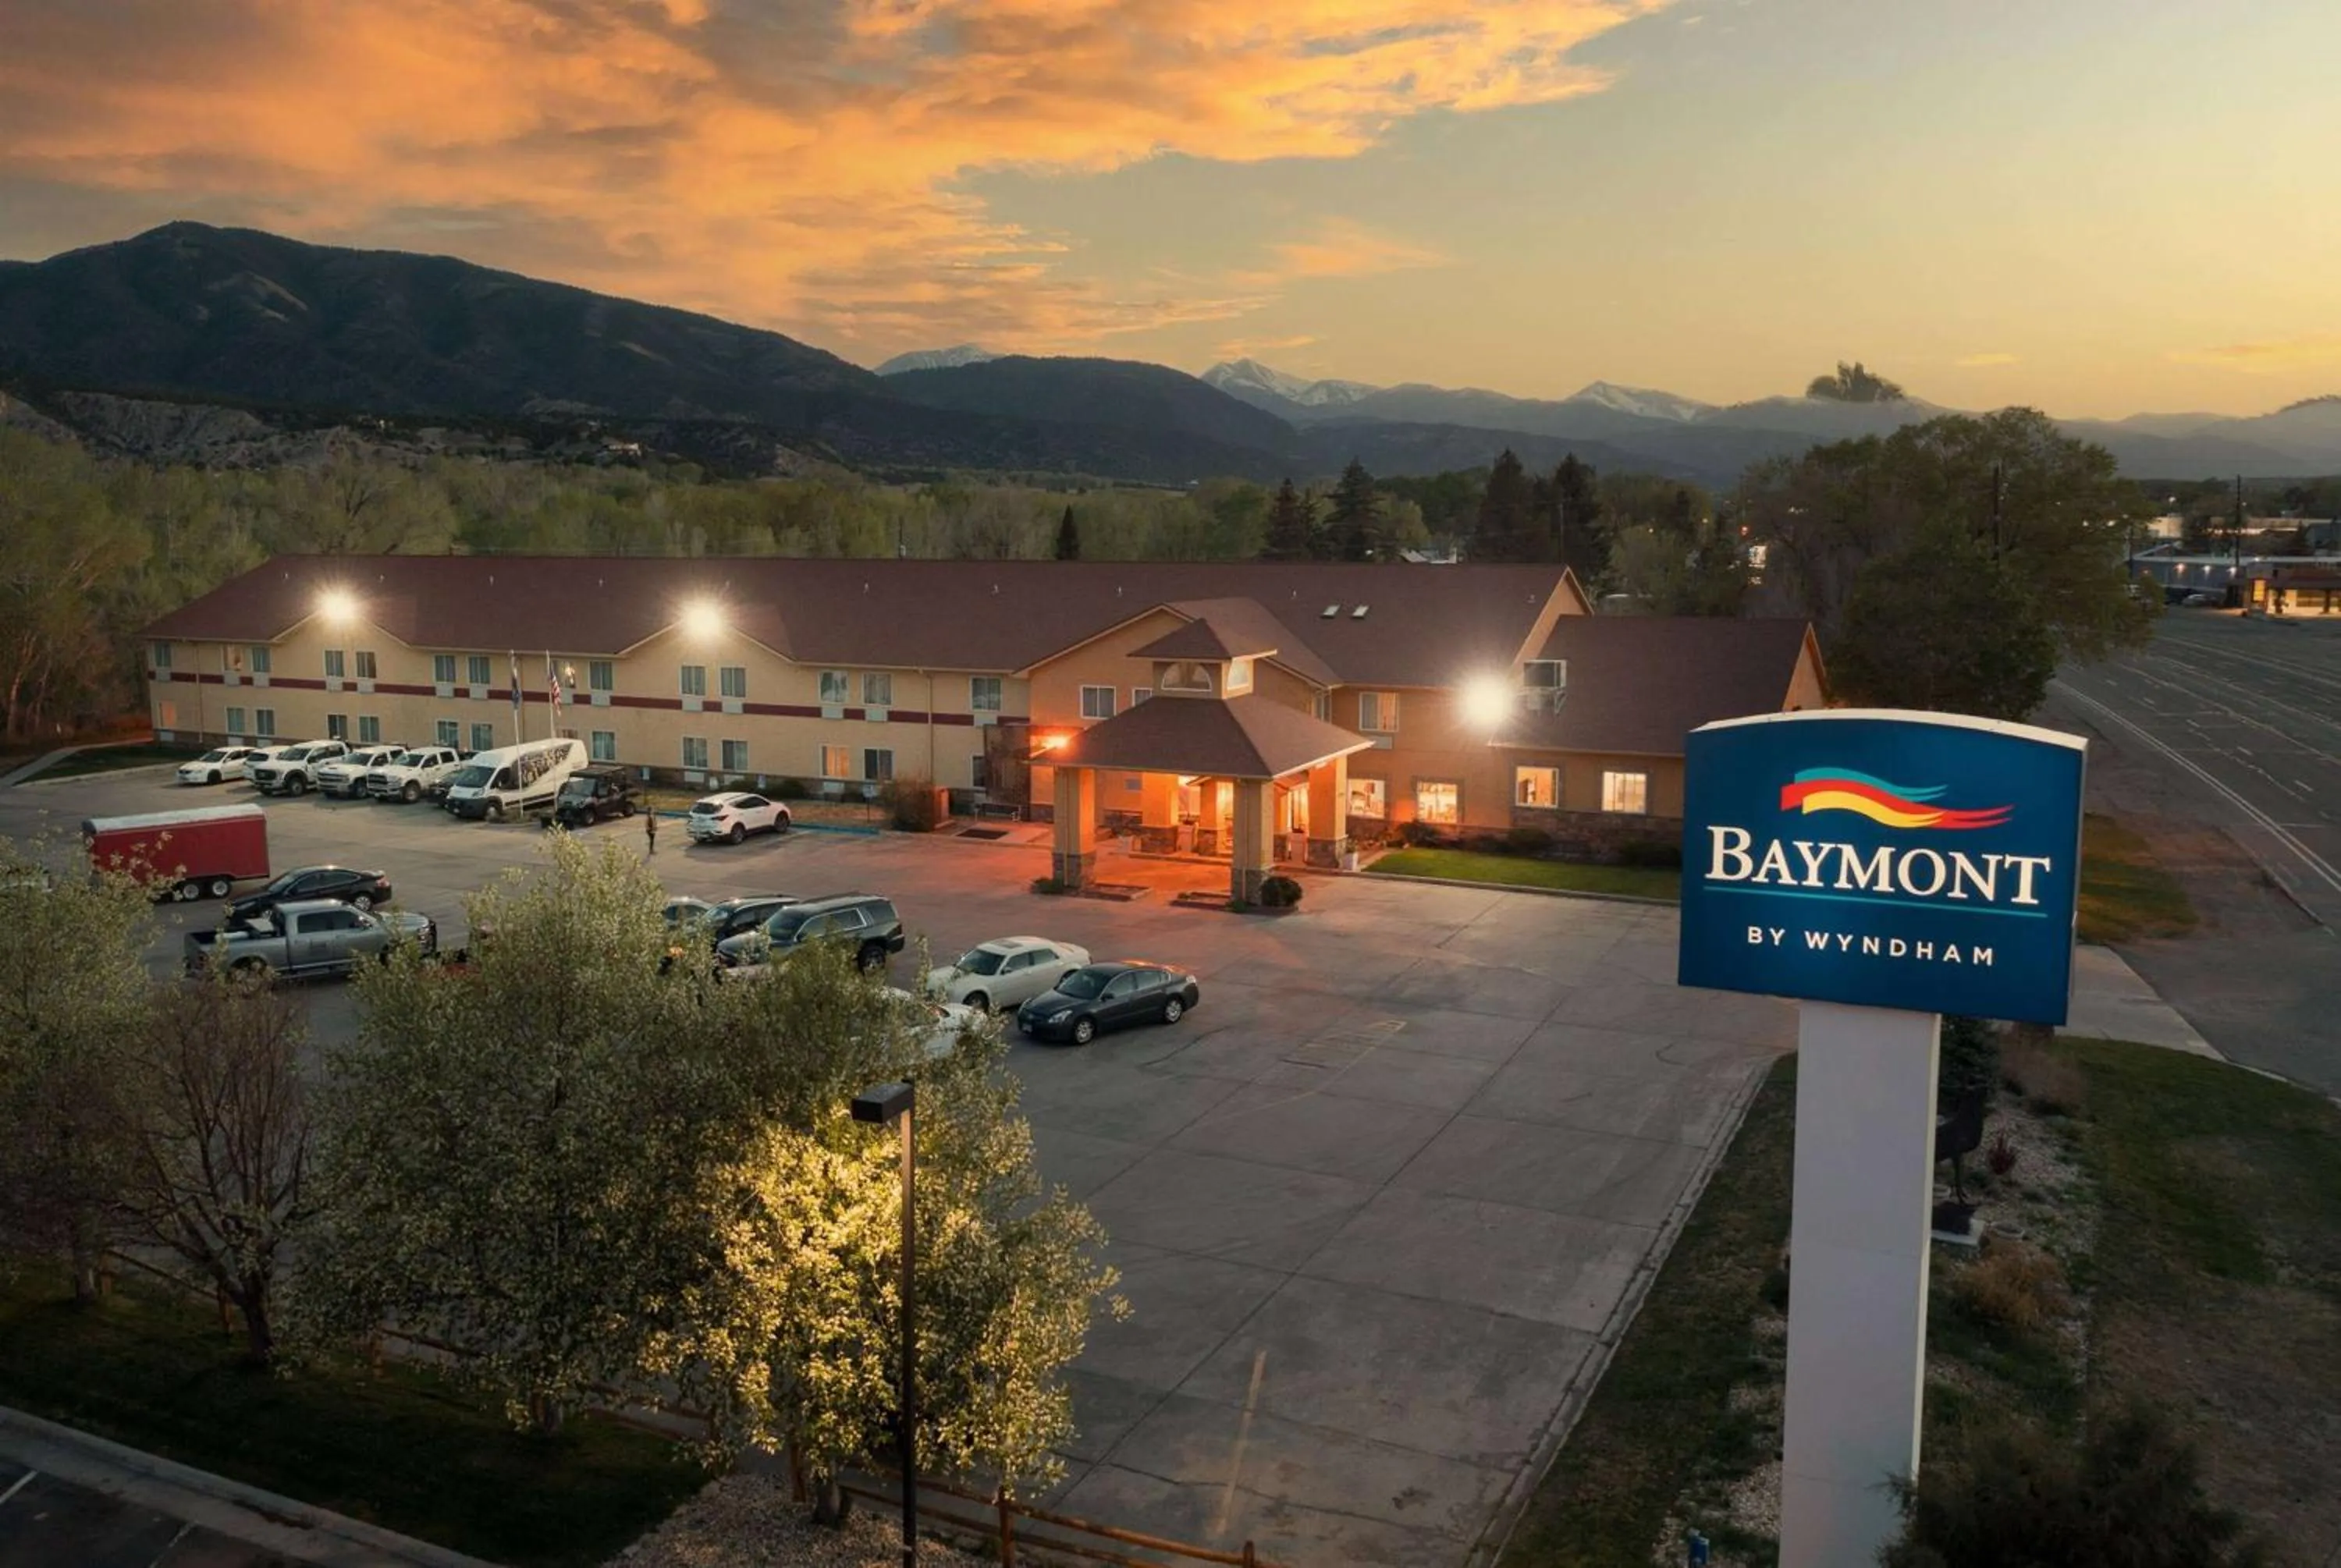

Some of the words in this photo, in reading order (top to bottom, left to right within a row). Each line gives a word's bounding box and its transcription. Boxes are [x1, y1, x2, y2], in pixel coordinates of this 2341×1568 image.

[1705, 825, 2051, 905] BAYMONT
[1747, 926, 1785, 945] BY
[1804, 931, 1993, 966] WYNDHAM
